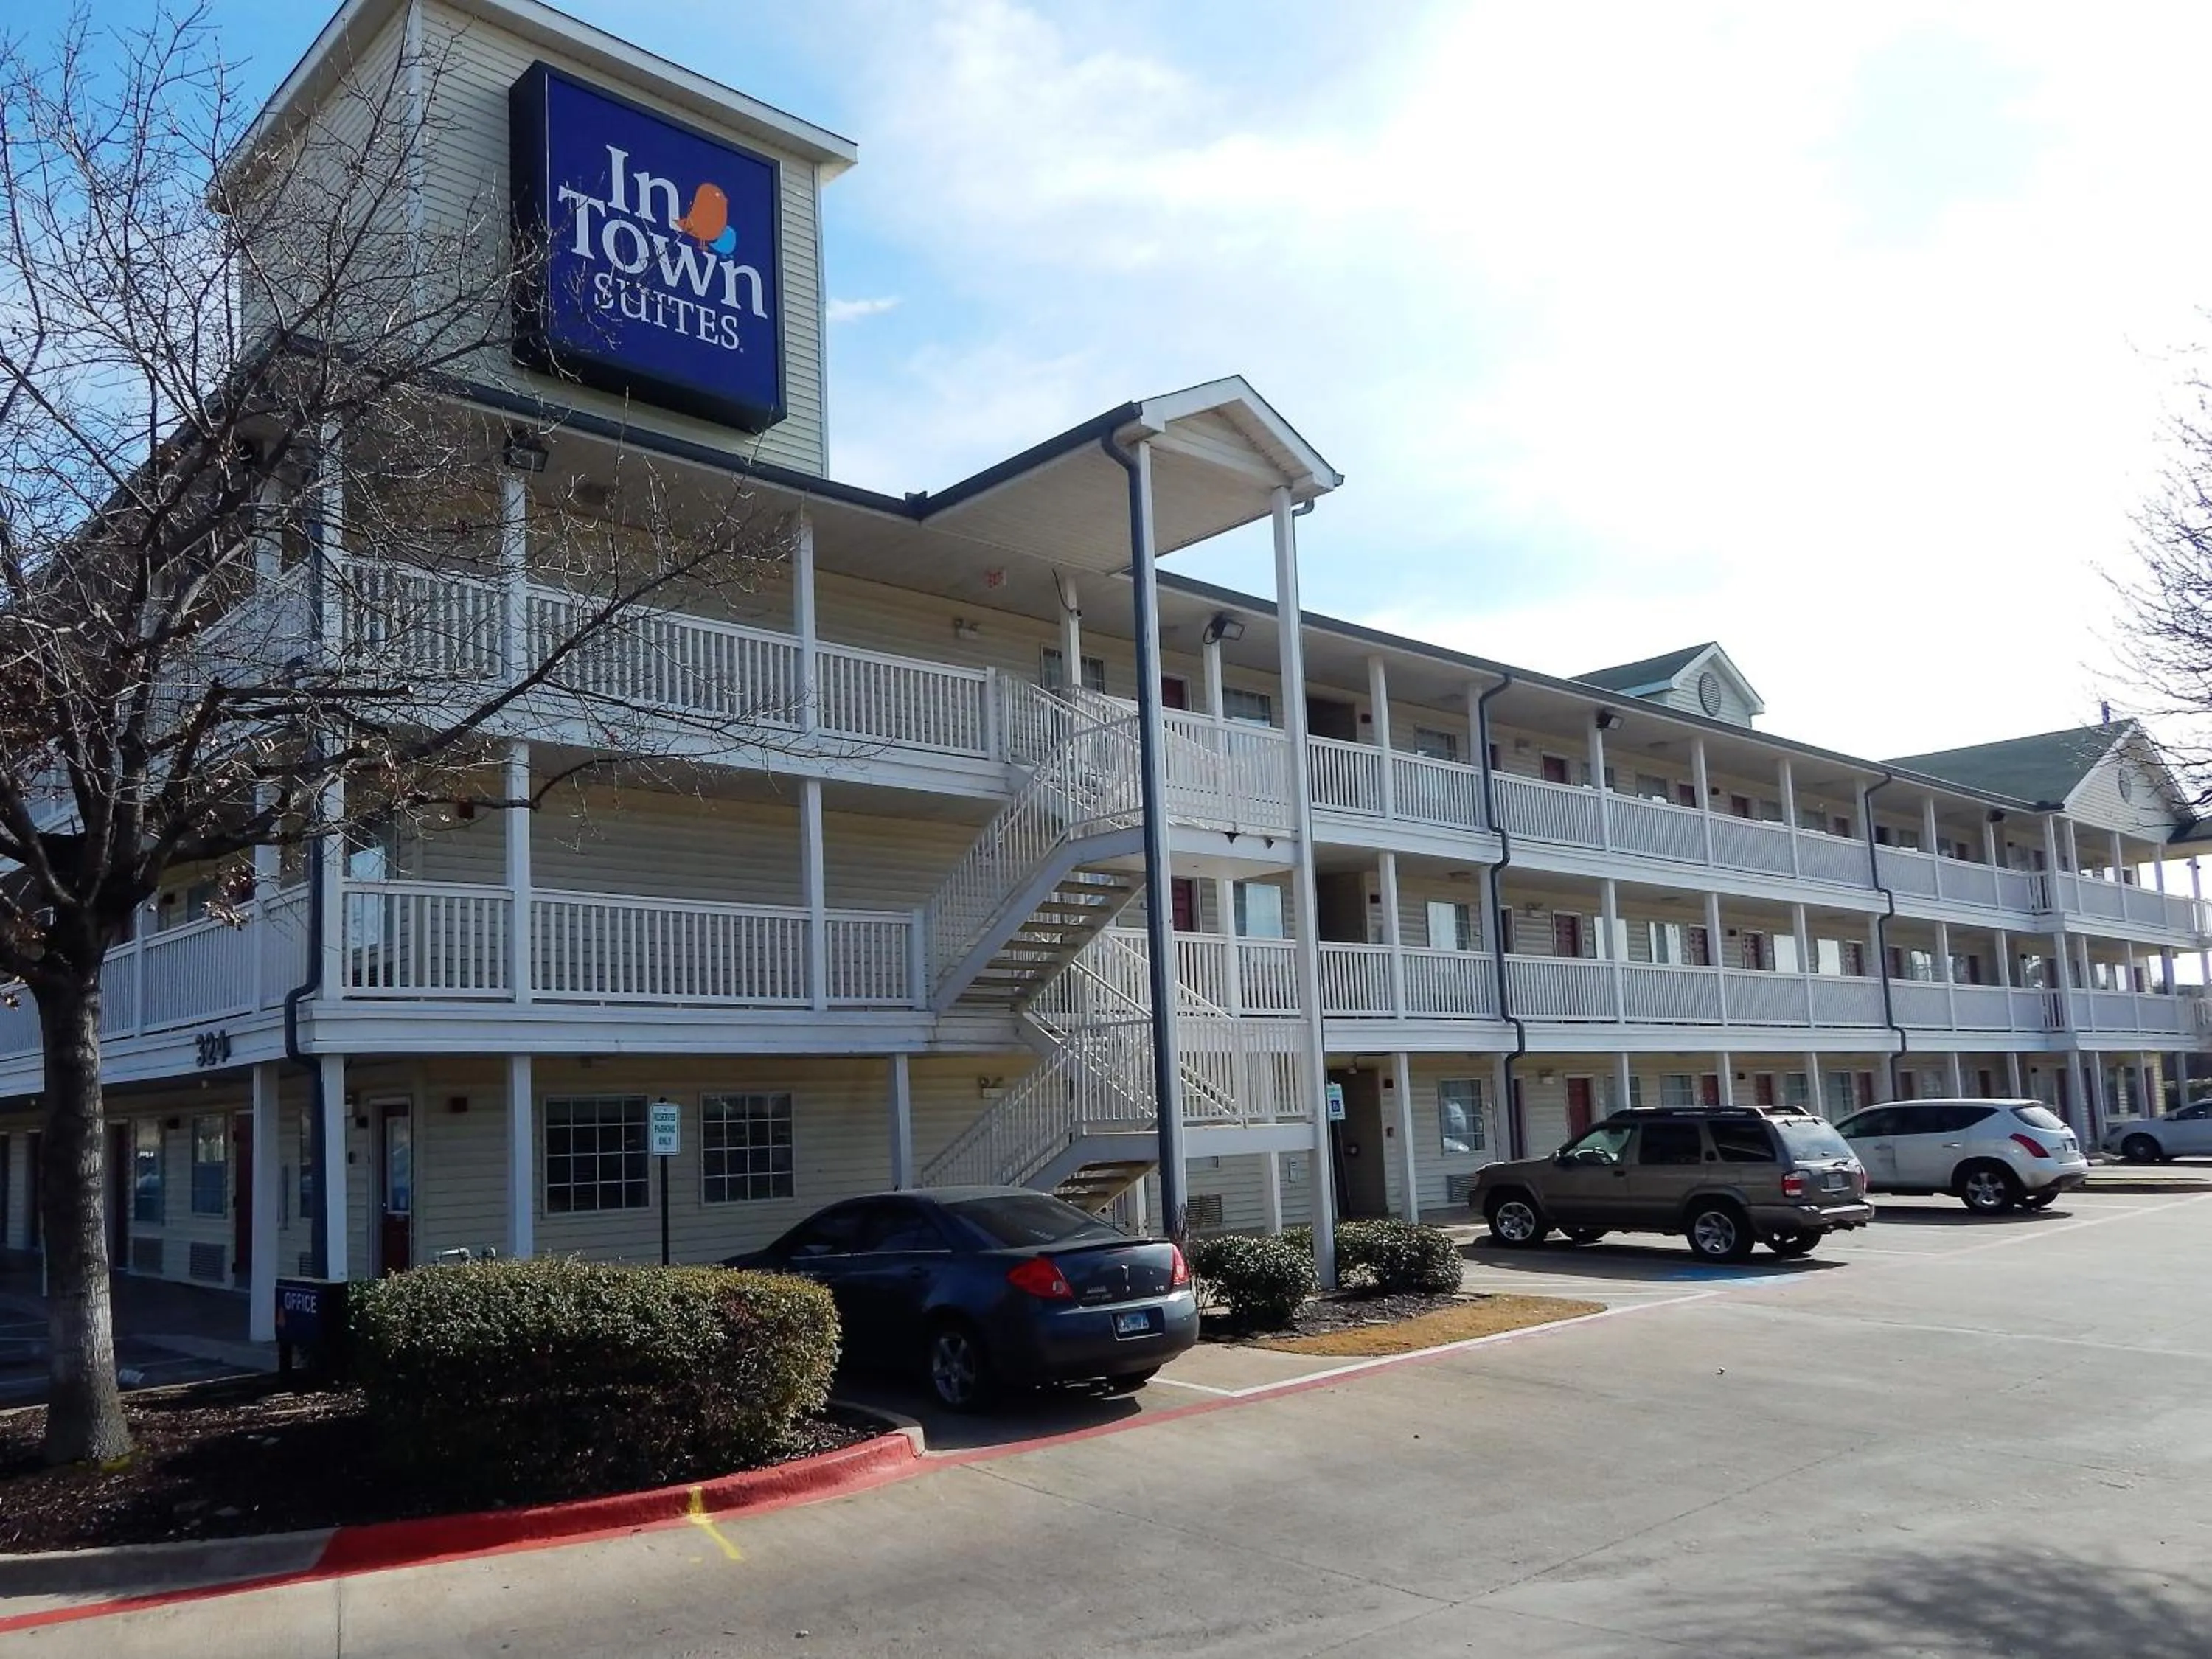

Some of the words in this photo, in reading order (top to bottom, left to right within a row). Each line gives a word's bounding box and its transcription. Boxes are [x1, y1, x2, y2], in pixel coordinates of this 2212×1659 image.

[605, 144, 684, 232] In
[557, 185, 768, 319] Town
[594, 271, 741, 352] SUITES
[195, 1029, 231, 1068] 324
[284, 1291, 317, 1314] OFFICE
